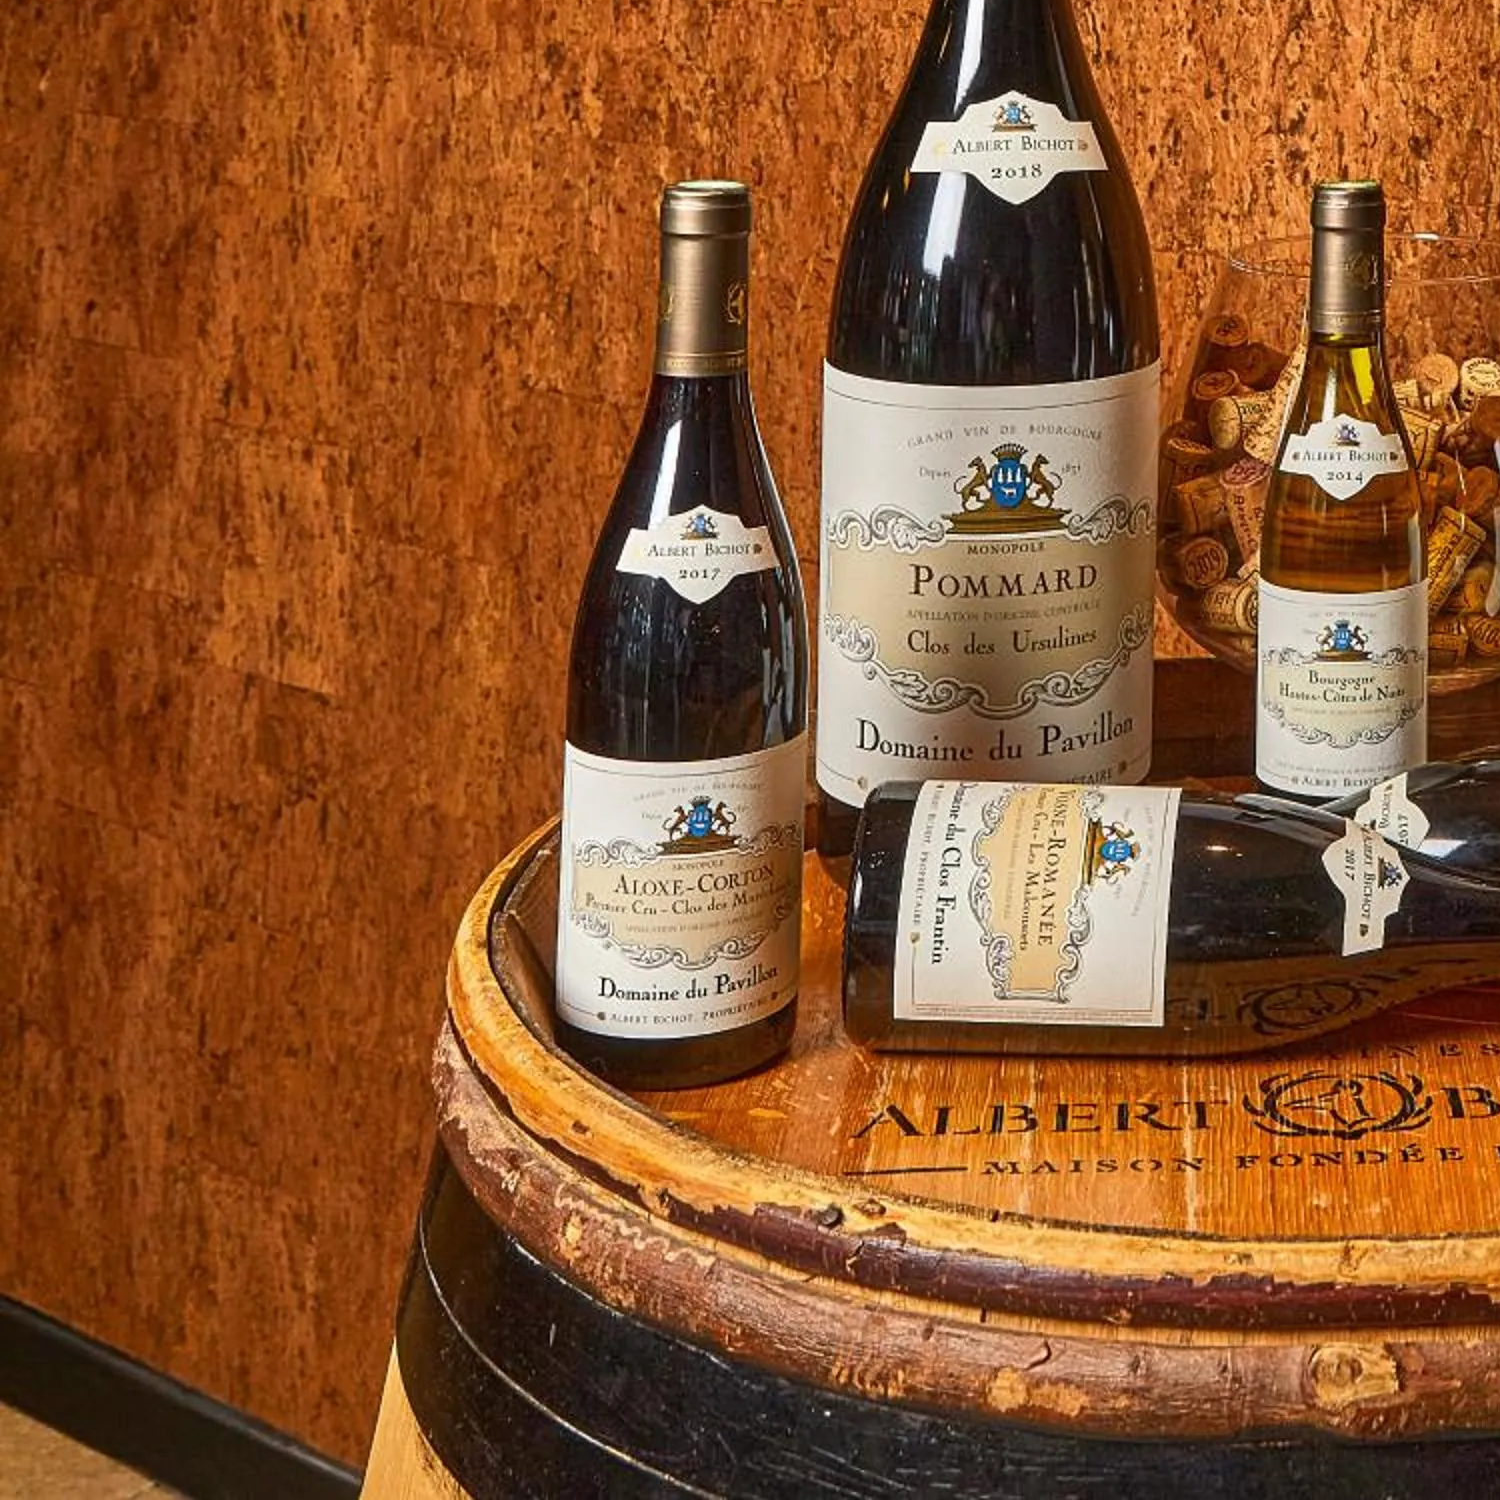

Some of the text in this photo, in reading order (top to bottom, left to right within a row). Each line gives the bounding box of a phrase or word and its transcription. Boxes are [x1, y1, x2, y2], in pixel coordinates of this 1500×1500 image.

[953, 135, 1075, 154] ALBERT BICHOT
[990, 163, 1043, 179] 2018
[1326, 471, 1364, 485] 2014
[648, 544, 698, 557] ALBERT
[966, 541, 1046, 556] MONOPOLE
[678, 568, 722, 581] 2017
[908, 562, 1099, 599] POMMARD
[906, 624, 1098, 655] Clos des Ursulines
[1308, 669, 1377, 691] Bourgogne
[1359, 689, 1374, 703] de
[855, 710, 1134, 762] Domaine du Pavillon
[944, 823, 967, 842] du
[937, 846, 963, 888] Clos
[613, 863, 777, 896] ALOXE-CORTON
[631, 898, 658, 916] Cru
[671, 899, 703, 915] Clos
[706, 897, 728, 913] des
[930, 894, 957, 966] Frantin
[597, 963, 778, 1001] Domaine du Pavillon
[852, 1100, 1230, 1138] ALBERT
[980, 1157, 1206, 1176] MAISON
[1235, 1144, 1466, 1169] FONDÉE
